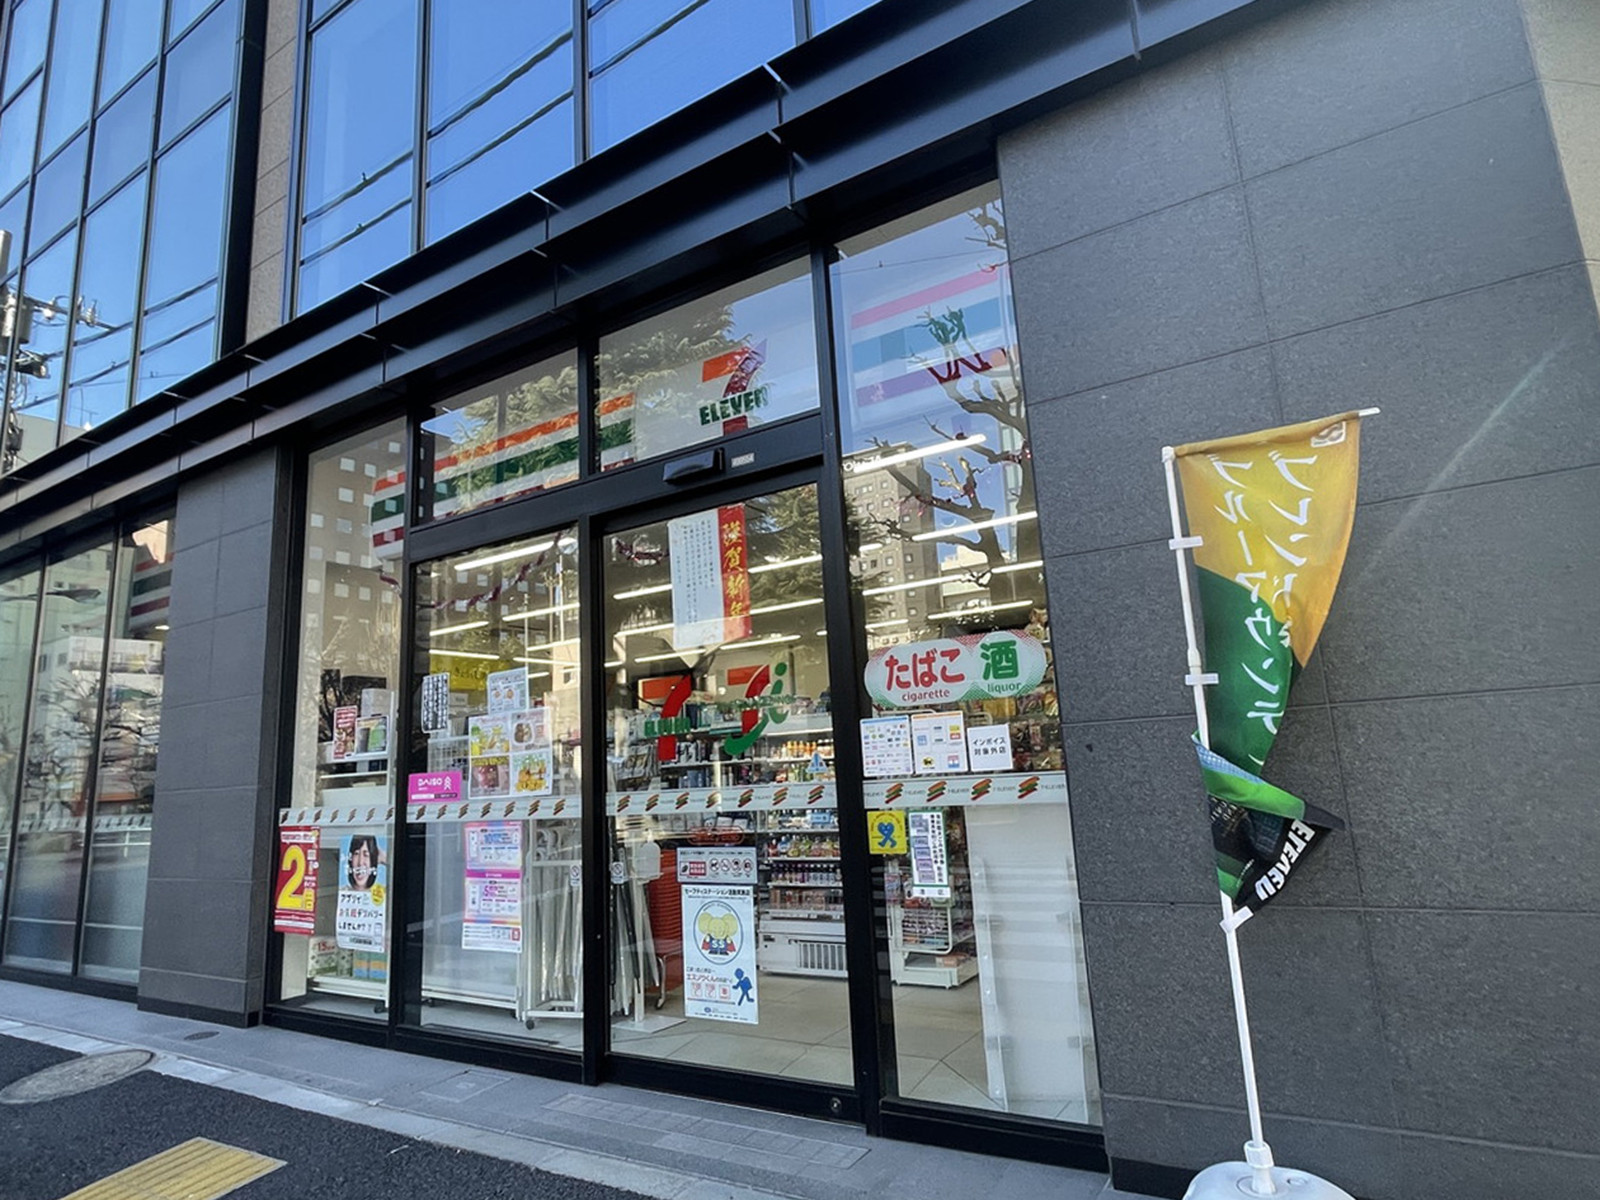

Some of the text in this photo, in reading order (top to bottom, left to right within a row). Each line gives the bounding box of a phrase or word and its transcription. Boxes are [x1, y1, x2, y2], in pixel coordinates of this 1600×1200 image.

[980, 639, 1020, 681] 酒
[885, 648, 966, 691] たばこ
[986, 681, 1022, 694] liquor
[901, 689, 951, 702] cigarette
[972, 736, 1007, 747] インボイス
[417, 778, 443, 787] DAISO
[276, 845, 306, 909] 2
